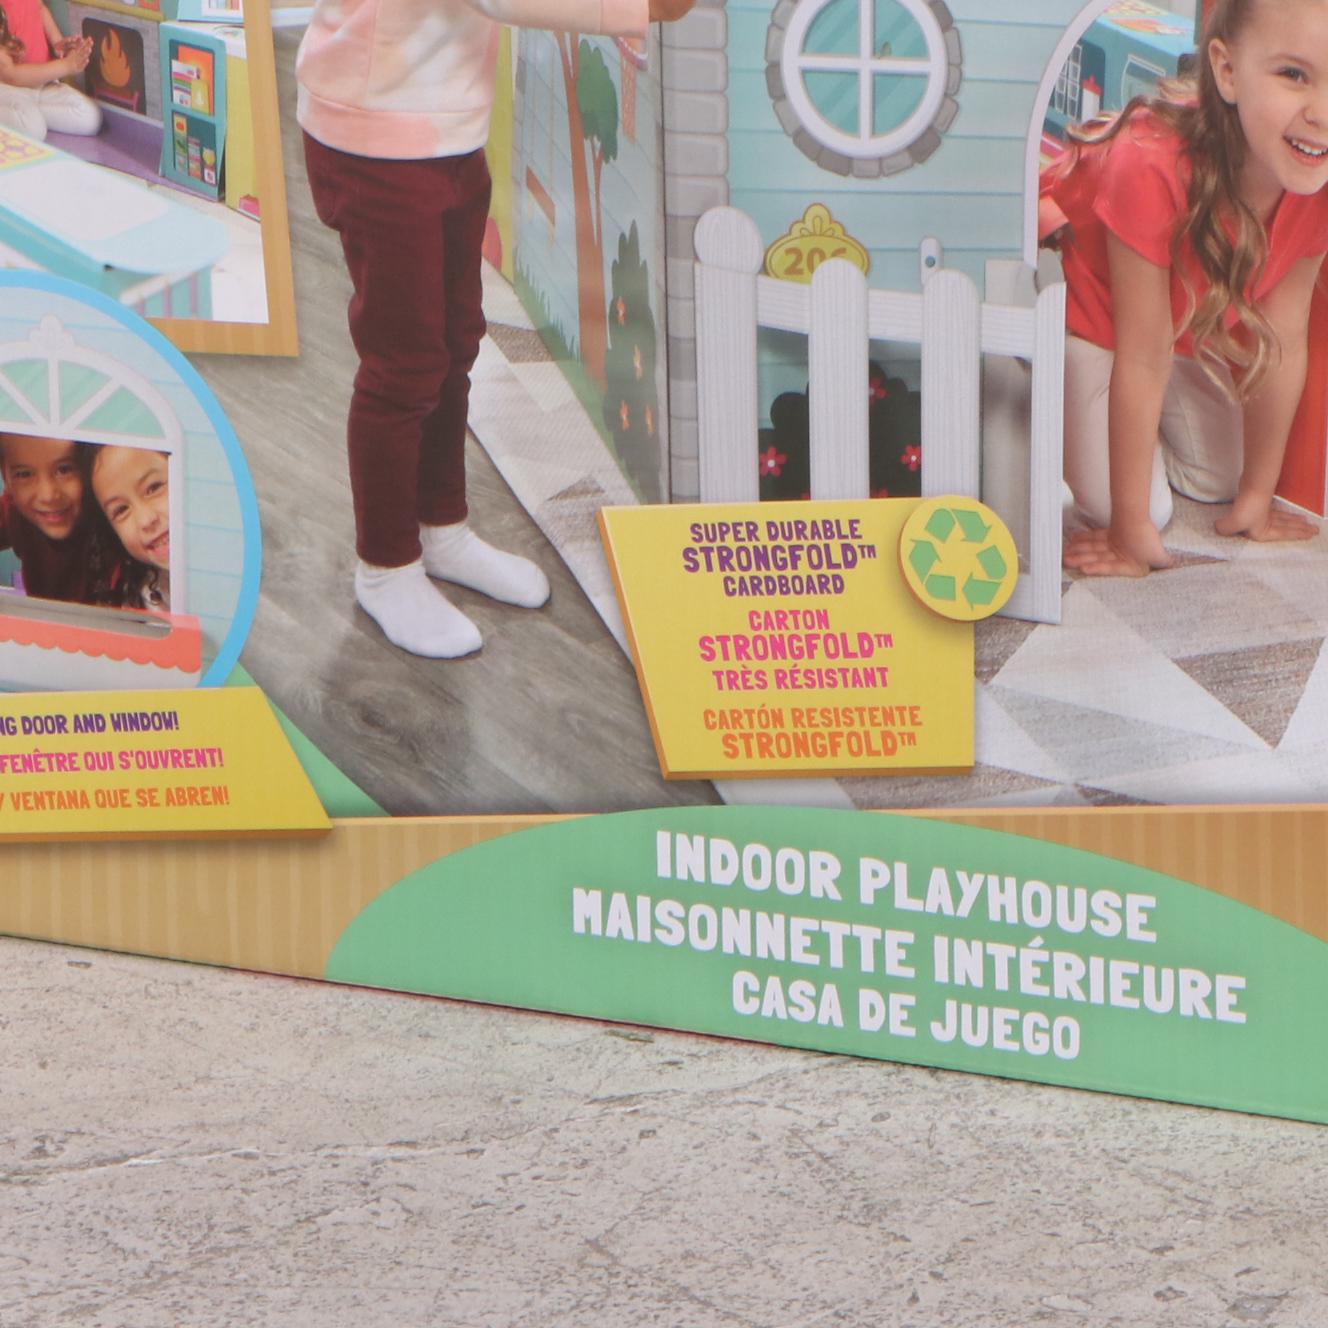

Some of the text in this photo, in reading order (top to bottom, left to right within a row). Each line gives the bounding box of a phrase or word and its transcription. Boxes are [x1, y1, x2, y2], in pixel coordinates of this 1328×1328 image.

[689, 519, 862, 543] SUPER DURABLE
[723, 574, 844, 597] CARDBOARD
[748, 610, 829, 632] CARTON
[713, 664, 888, 691] TRÈS RÉSISTANT
[22, 715, 68, 736] DOOR
[73, 713, 106, 734] AND
[111, 711, 179, 733] WINDOW!
[704, 704, 922, 730] CARTÓN RESISTENTE
[0, 749, 79, 774] FENÊTRE
[85, 751, 114, 771] QUI
[119, 748, 224, 771] S'OUVRENT!
[11, 790, 90, 812] VENTANA
[95, 790, 132, 809] QUE
[138, 788, 159, 808] SE
[165, 786, 230, 807] ABREN!
[655, 830, 1157, 943] INDOOR PLAYHOUSE
[572, 888, 1247, 1024] MAISONNETTE INTÉRIEURE
[731, 970, 1080, 1060] CASA DE JUEGO
